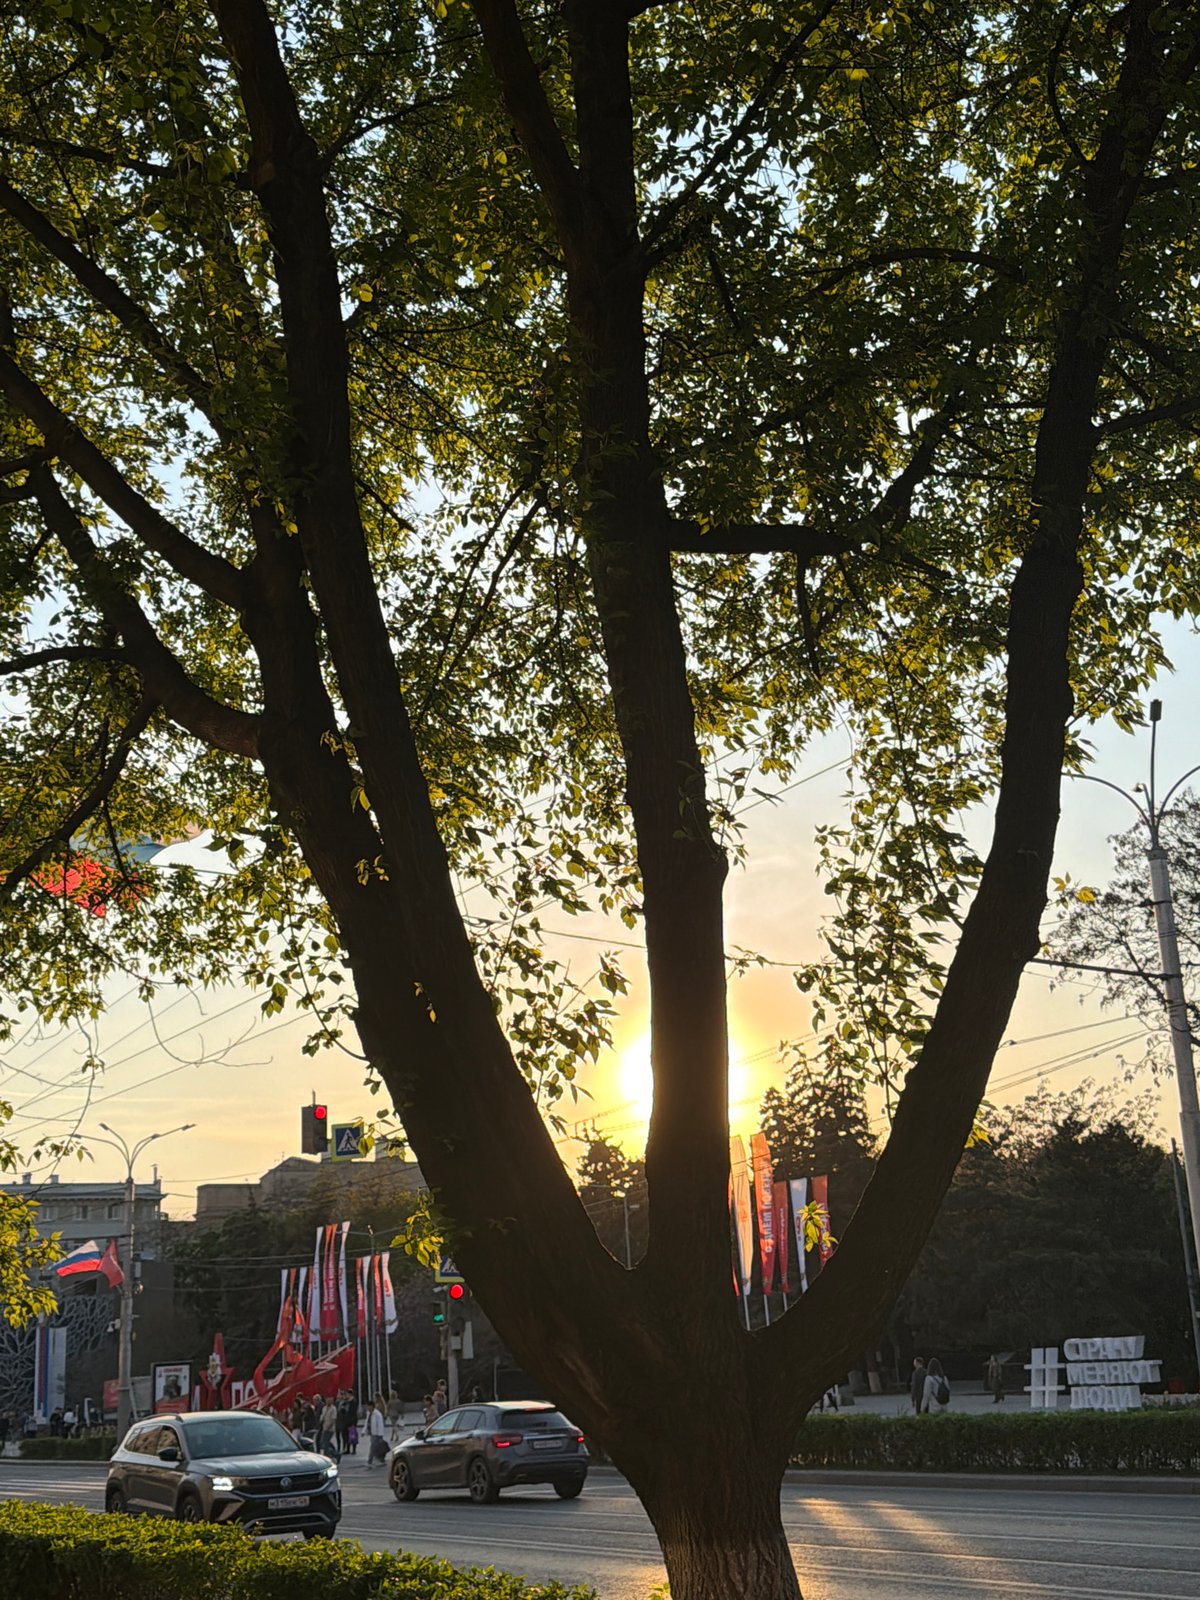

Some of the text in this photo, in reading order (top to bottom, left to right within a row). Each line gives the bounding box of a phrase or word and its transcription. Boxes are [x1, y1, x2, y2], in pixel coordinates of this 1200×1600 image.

[1063, 1335, 1146, 1361] СТРАНУ
[1066, 1359, 1163, 1385] МЕНЯЮТ
[1070, 1385, 1142, 1411] ЛЮДИ
